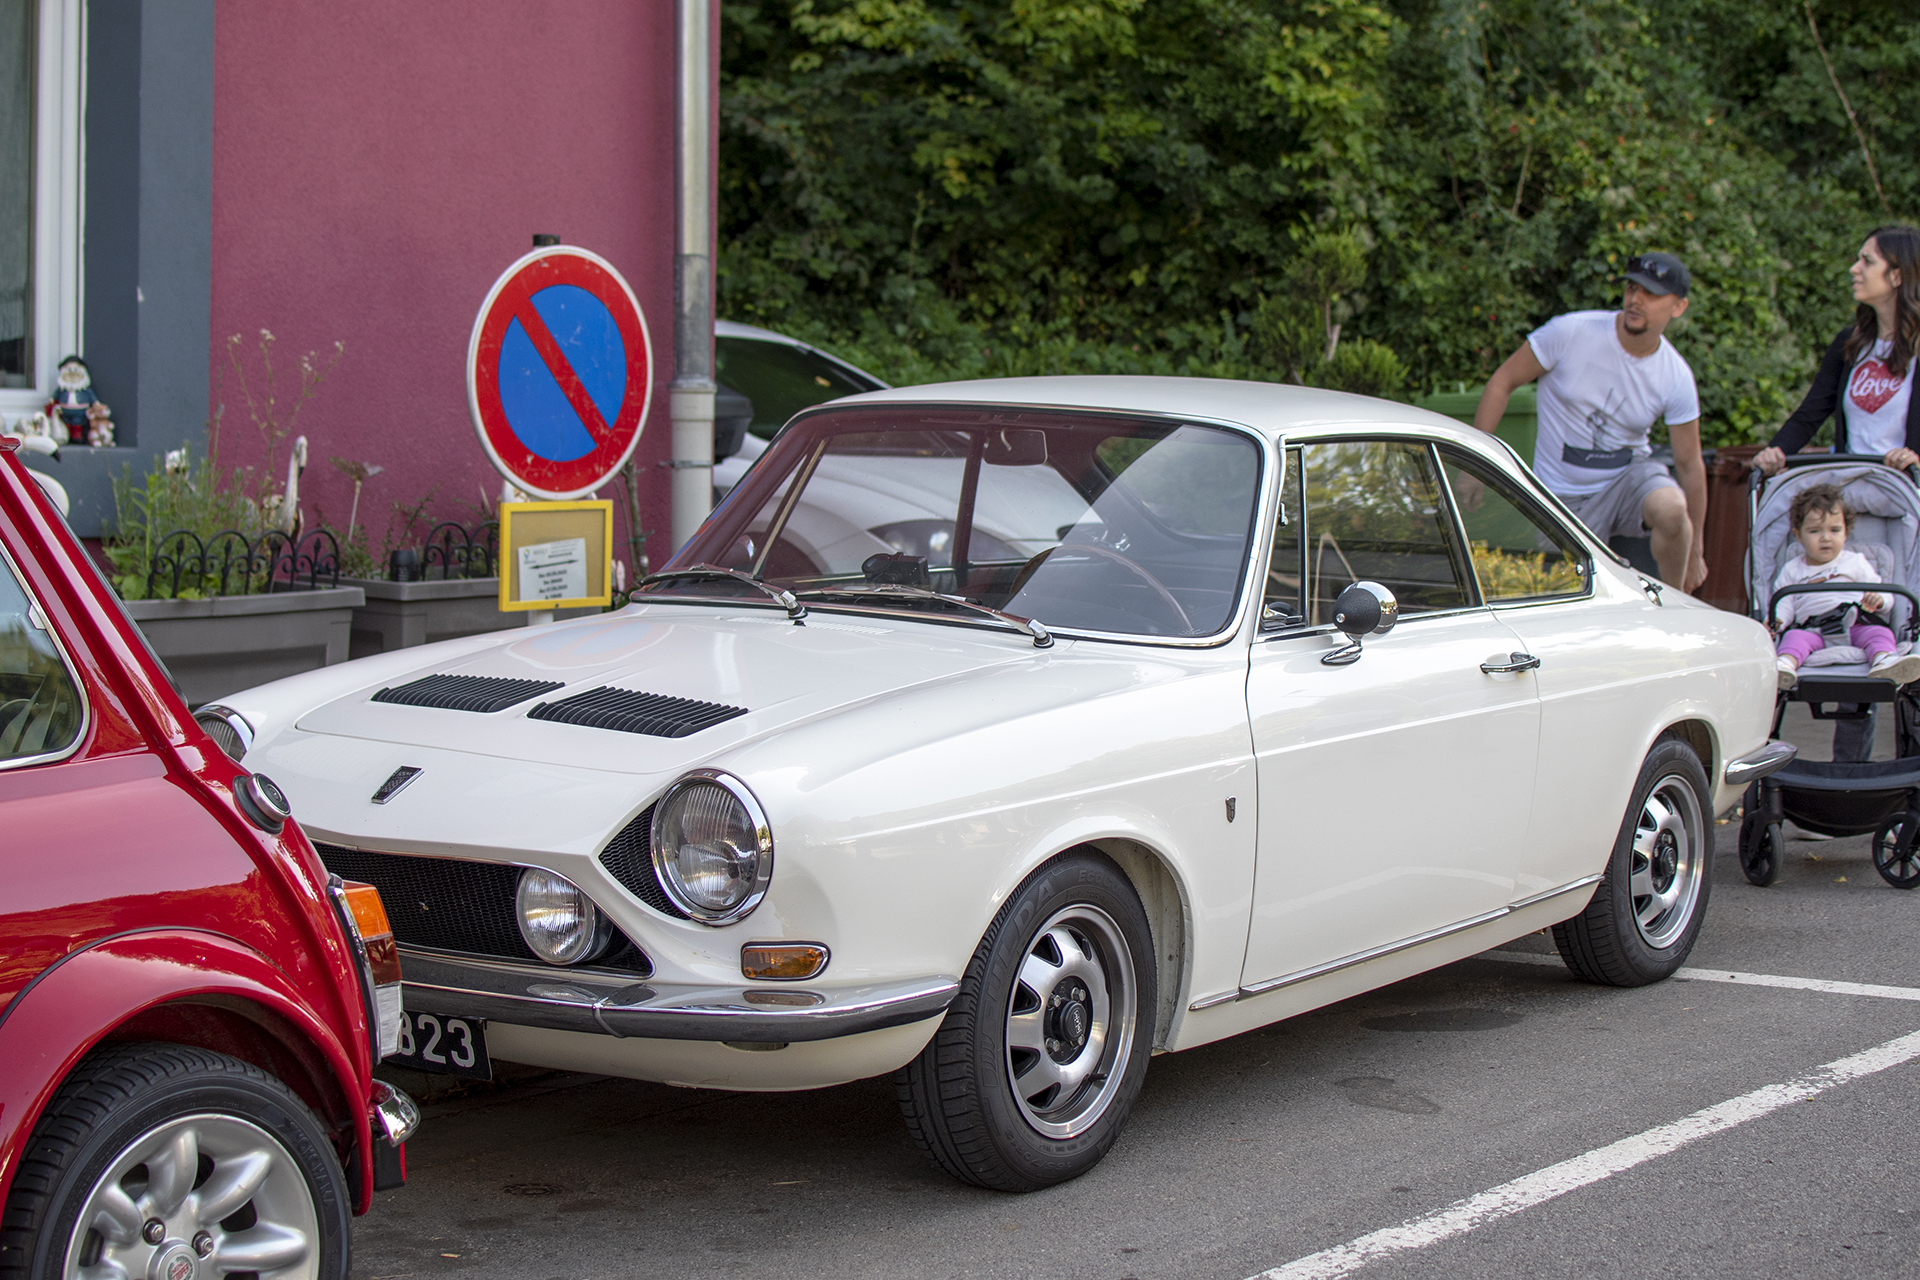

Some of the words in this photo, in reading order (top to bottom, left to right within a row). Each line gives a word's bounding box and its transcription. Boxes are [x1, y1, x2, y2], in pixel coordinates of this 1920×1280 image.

[1850, 367, 1904, 397] love
[981, 879, 1056, 1034] FULDA
[293, 1128, 336, 1210] YOKOHAMA
